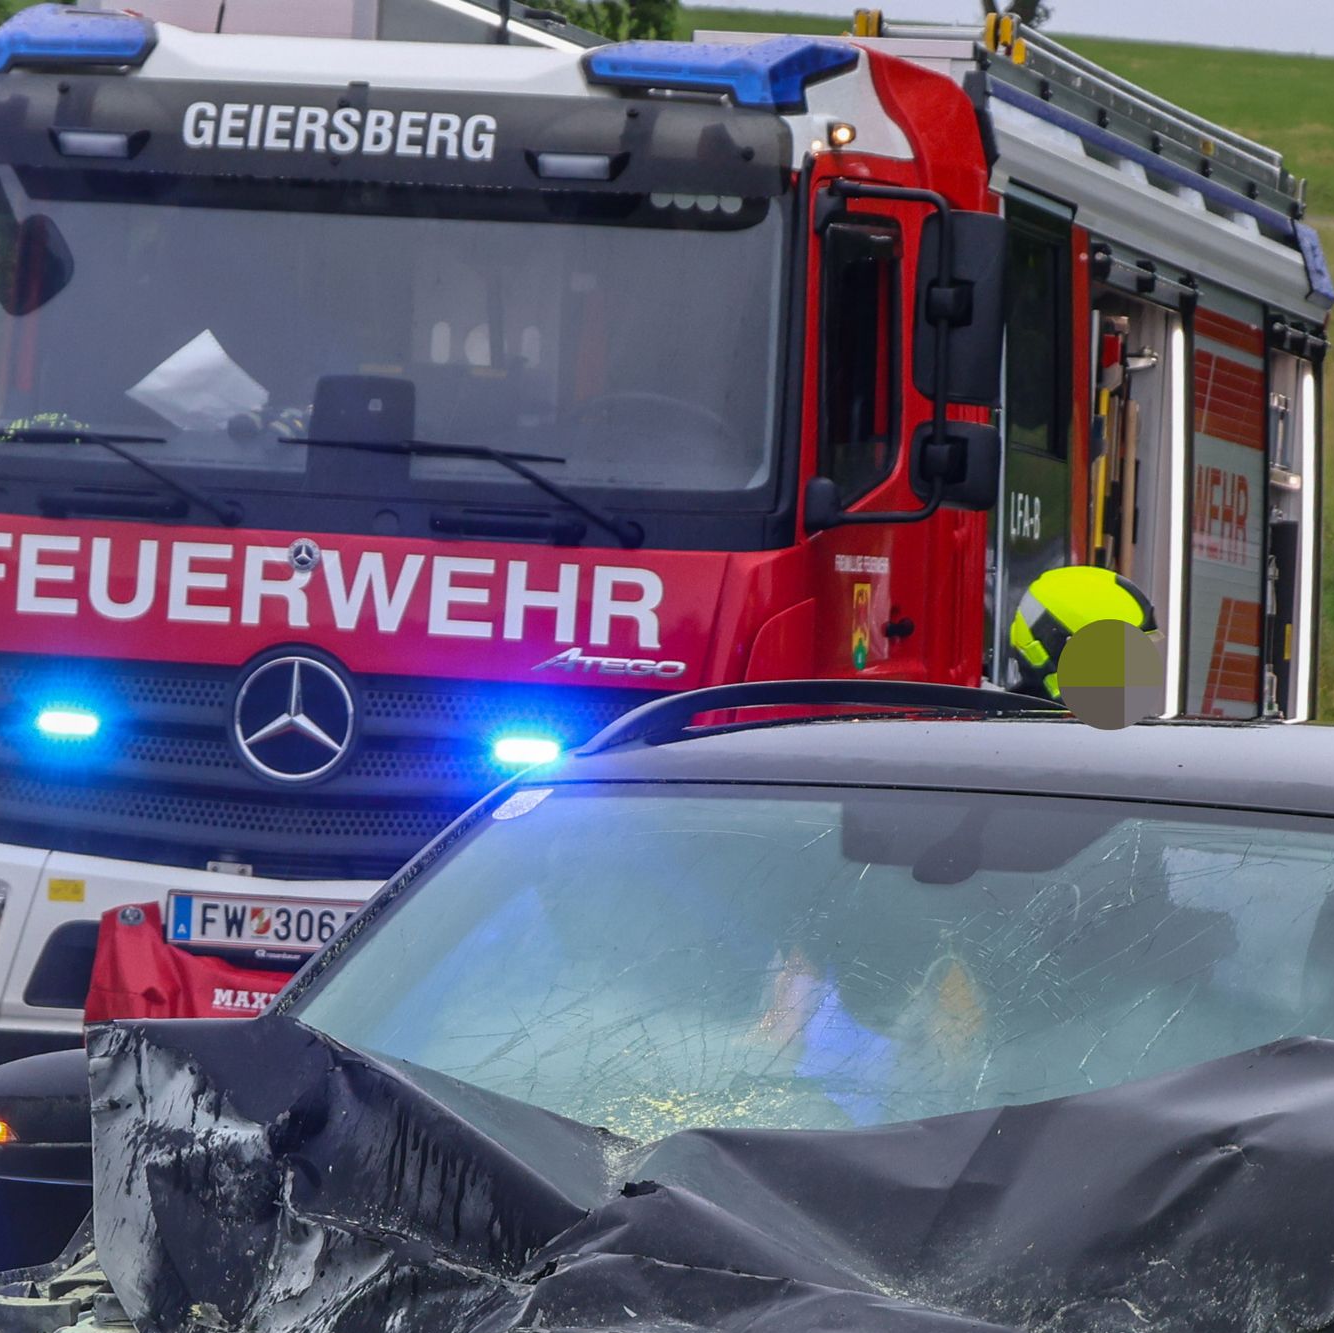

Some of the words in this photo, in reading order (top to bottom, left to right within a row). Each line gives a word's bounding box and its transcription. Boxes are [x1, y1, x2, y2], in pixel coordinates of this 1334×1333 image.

[182, 101, 497, 162] GEIERSBERG
[530, 647, 687, 678] ATEGO
[176, 923, 188, 934] A
[201, 902, 247, 938] FW
